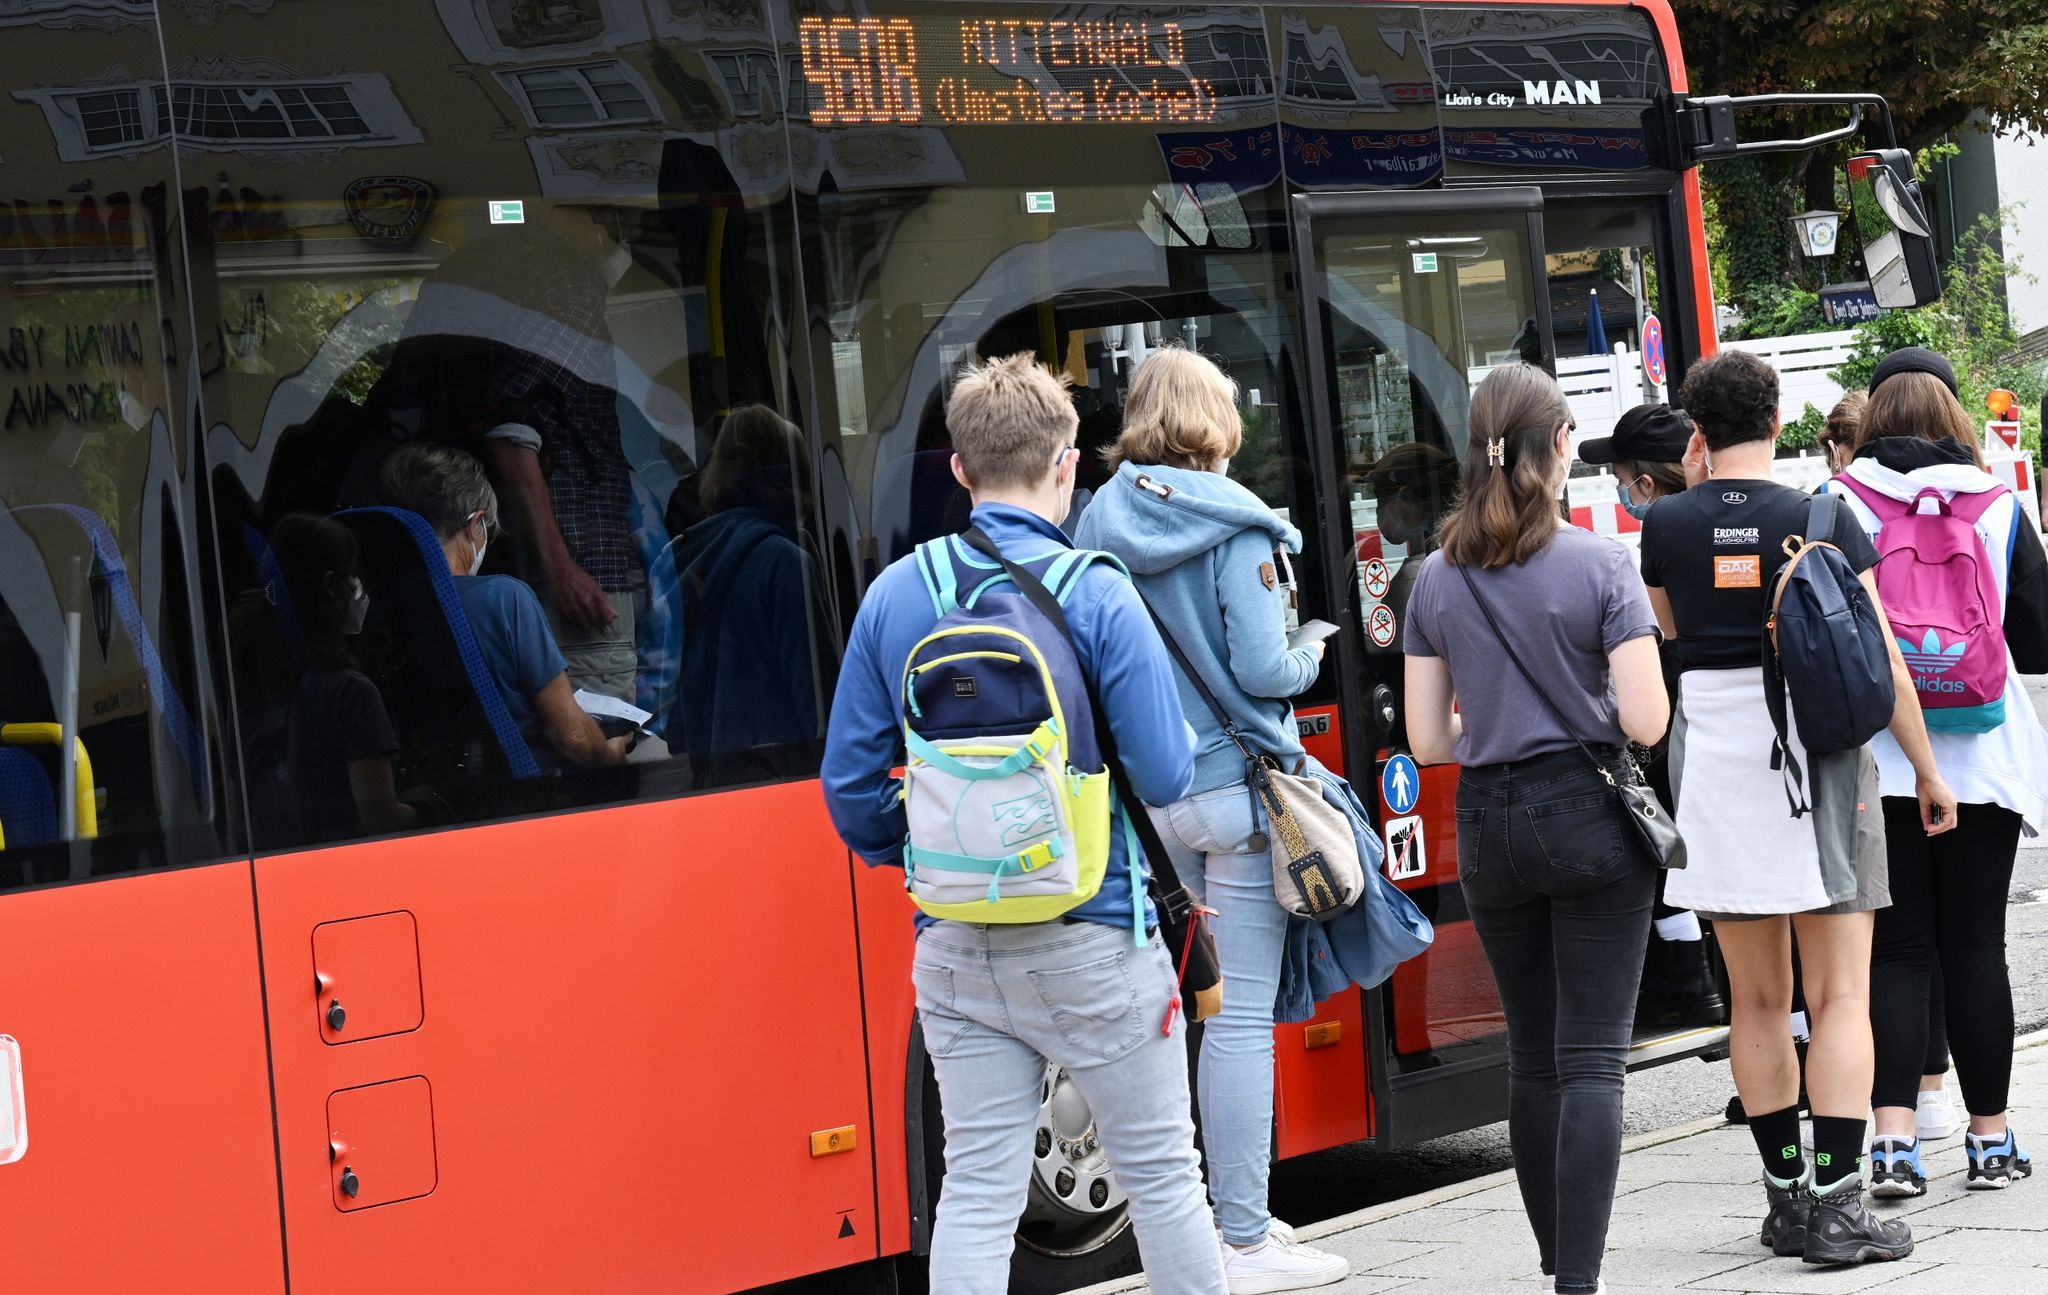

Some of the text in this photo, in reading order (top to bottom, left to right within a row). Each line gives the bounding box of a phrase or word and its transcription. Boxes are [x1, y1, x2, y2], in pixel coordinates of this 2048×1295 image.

[960, 20, 1184, 65] MITTENWALD
[1445, 92, 1482, 106] Lion's
[1487, 92, 1515, 107] City
[1523, 80, 1601, 105] MAN
[1713, 527, 1760, 538] ERDINGER
[1718, 560, 1756, 573] DAK
[1910, 675, 1966, 693] didas
